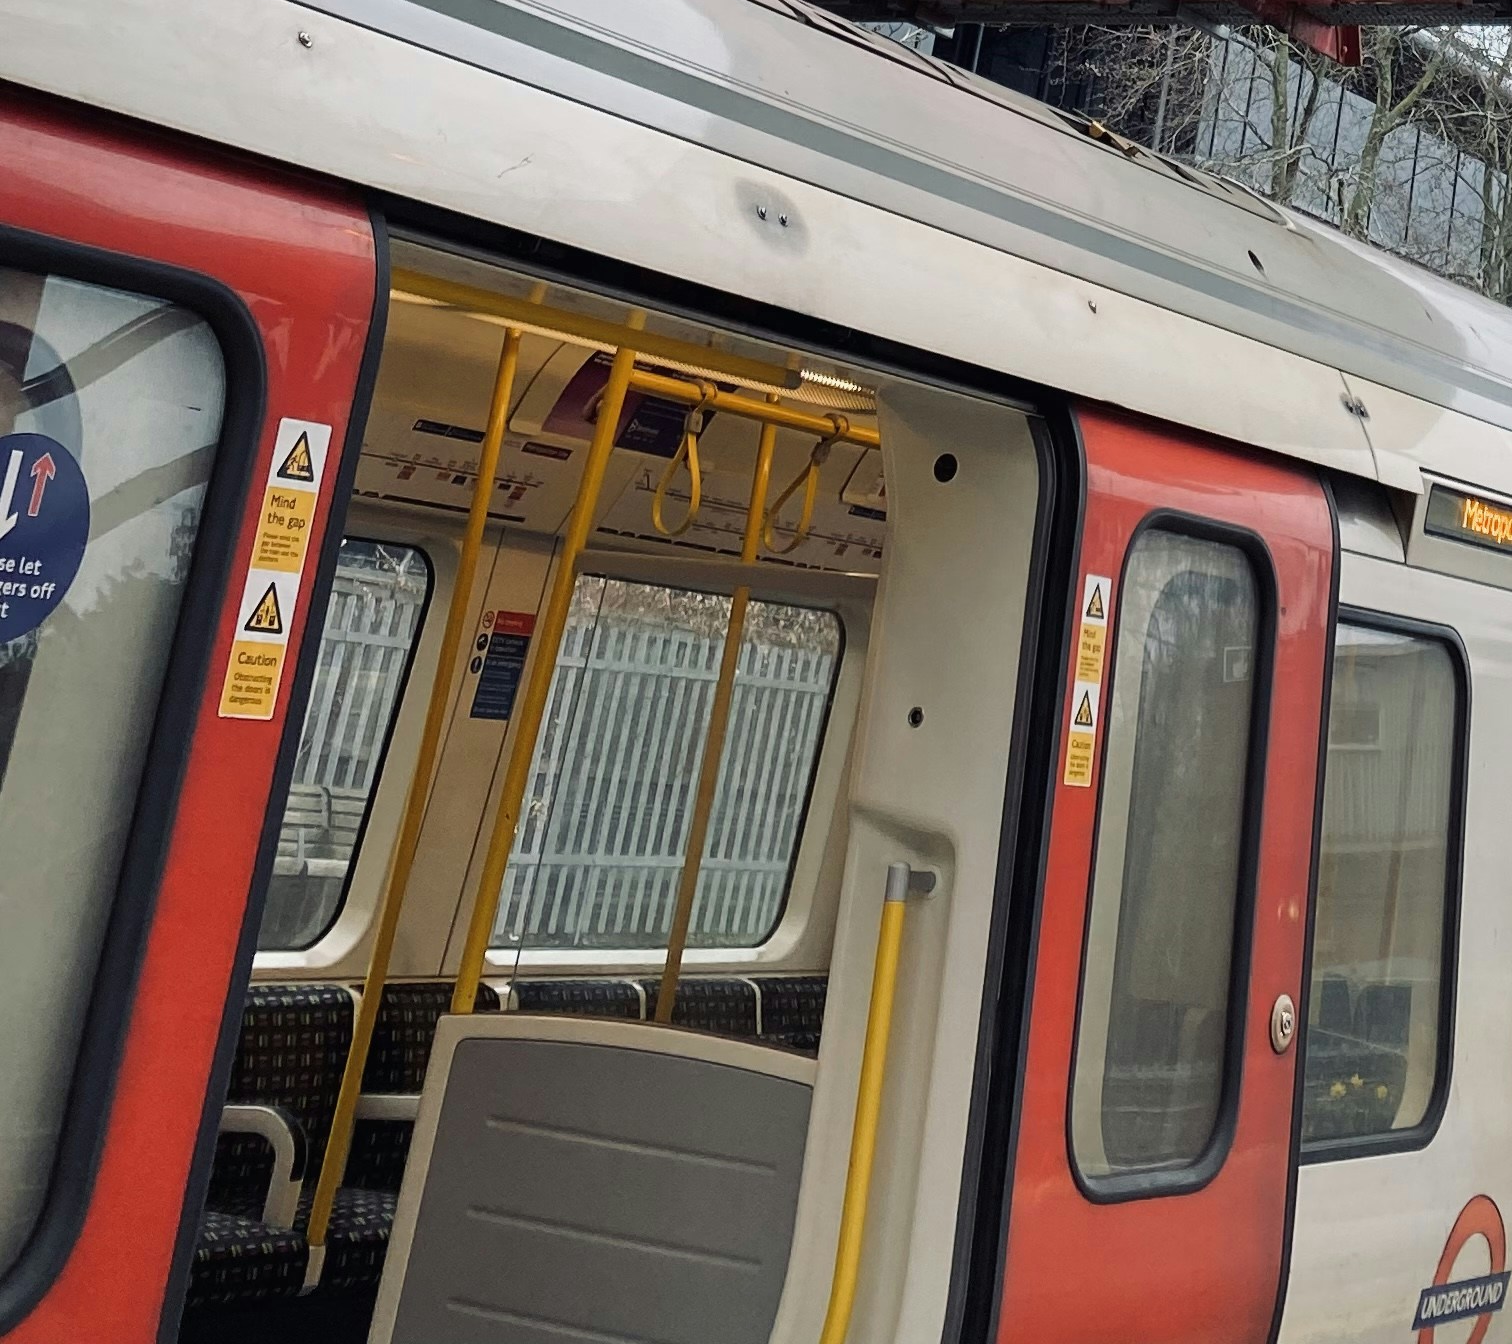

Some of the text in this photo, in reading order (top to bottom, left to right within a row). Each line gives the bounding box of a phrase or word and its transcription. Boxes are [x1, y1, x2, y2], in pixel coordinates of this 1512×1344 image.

[270, 494, 297, 510] Mind
[267, 512, 306, 531] the gap
[19, 556, 43, 576] let
[30, 582, 56, 600] off
[238, 651, 277, 667] Caution
[1420, 1281, 1503, 1320] UNDERGROUND
